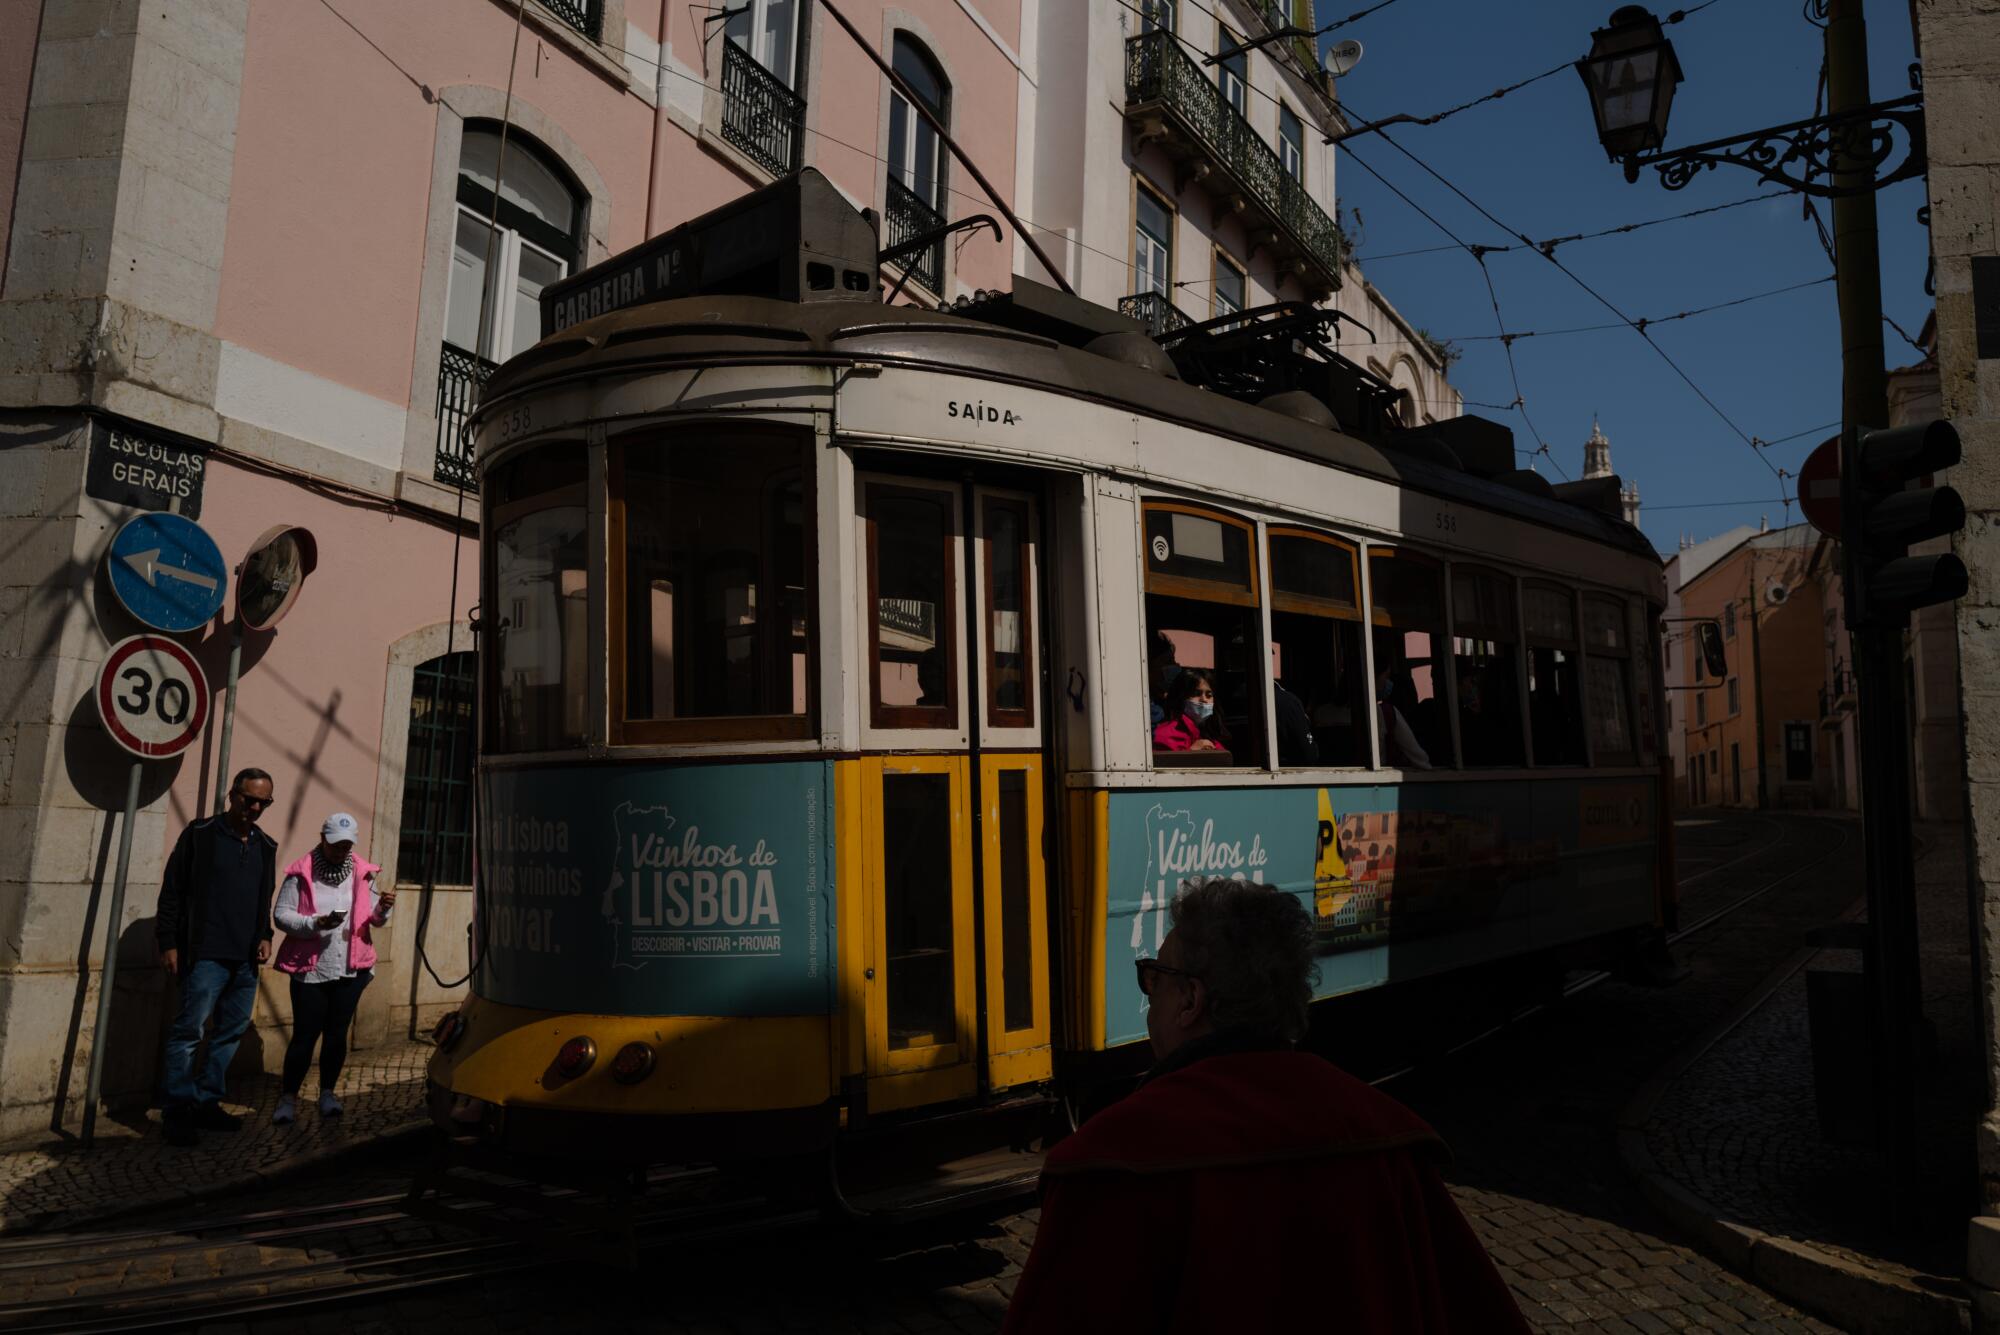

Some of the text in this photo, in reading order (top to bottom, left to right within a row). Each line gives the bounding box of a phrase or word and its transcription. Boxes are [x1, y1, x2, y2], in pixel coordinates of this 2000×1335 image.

[553, 265, 646, 332] CARREIRA
[656, 249, 681, 289] Nº
[948, 399, 1015, 426] SAÍDA
[109, 431, 204, 473] ESCOLAS
[112, 461, 192, 498] GERAIS
[117, 667, 191, 725] 30
[507, 812, 569, 854] Lisboa
[631, 825, 778, 869] Vinhos de
[1158, 818, 1268, 876] Vinhos de
[518, 859, 583, 897] vinhos
[631, 869, 780, 927] LISBOA
[631, 935, 781, 952] DESCOBRIR VISITAR PROVAR
